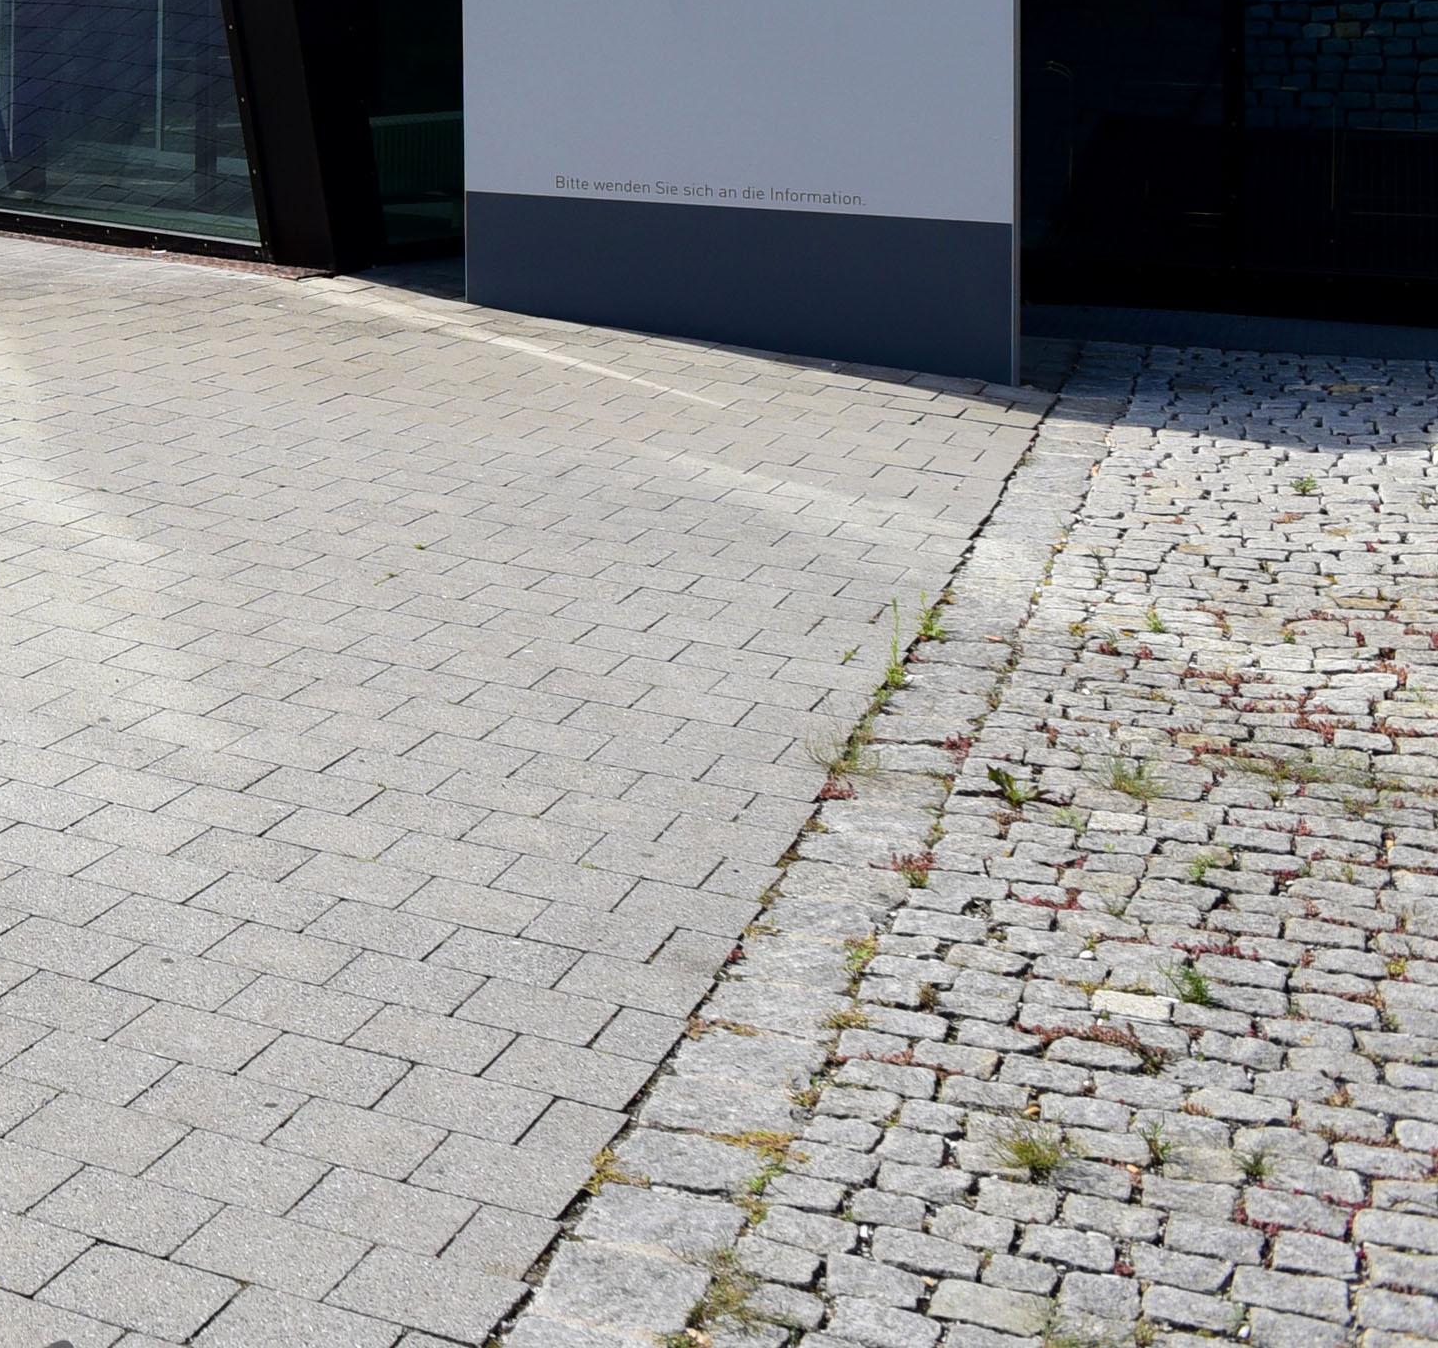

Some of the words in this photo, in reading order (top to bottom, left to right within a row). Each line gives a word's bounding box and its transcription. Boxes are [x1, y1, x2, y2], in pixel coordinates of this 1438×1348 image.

[555, 175, 589, 191] Bitte
[593, 179, 651, 195] wenden
[655, 181, 678, 196] Sie
[683, 183, 714, 198] sich
[718, 188, 738, 200] an
[742, 186, 765, 201] die
[770, 187, 867, 206] Information.
